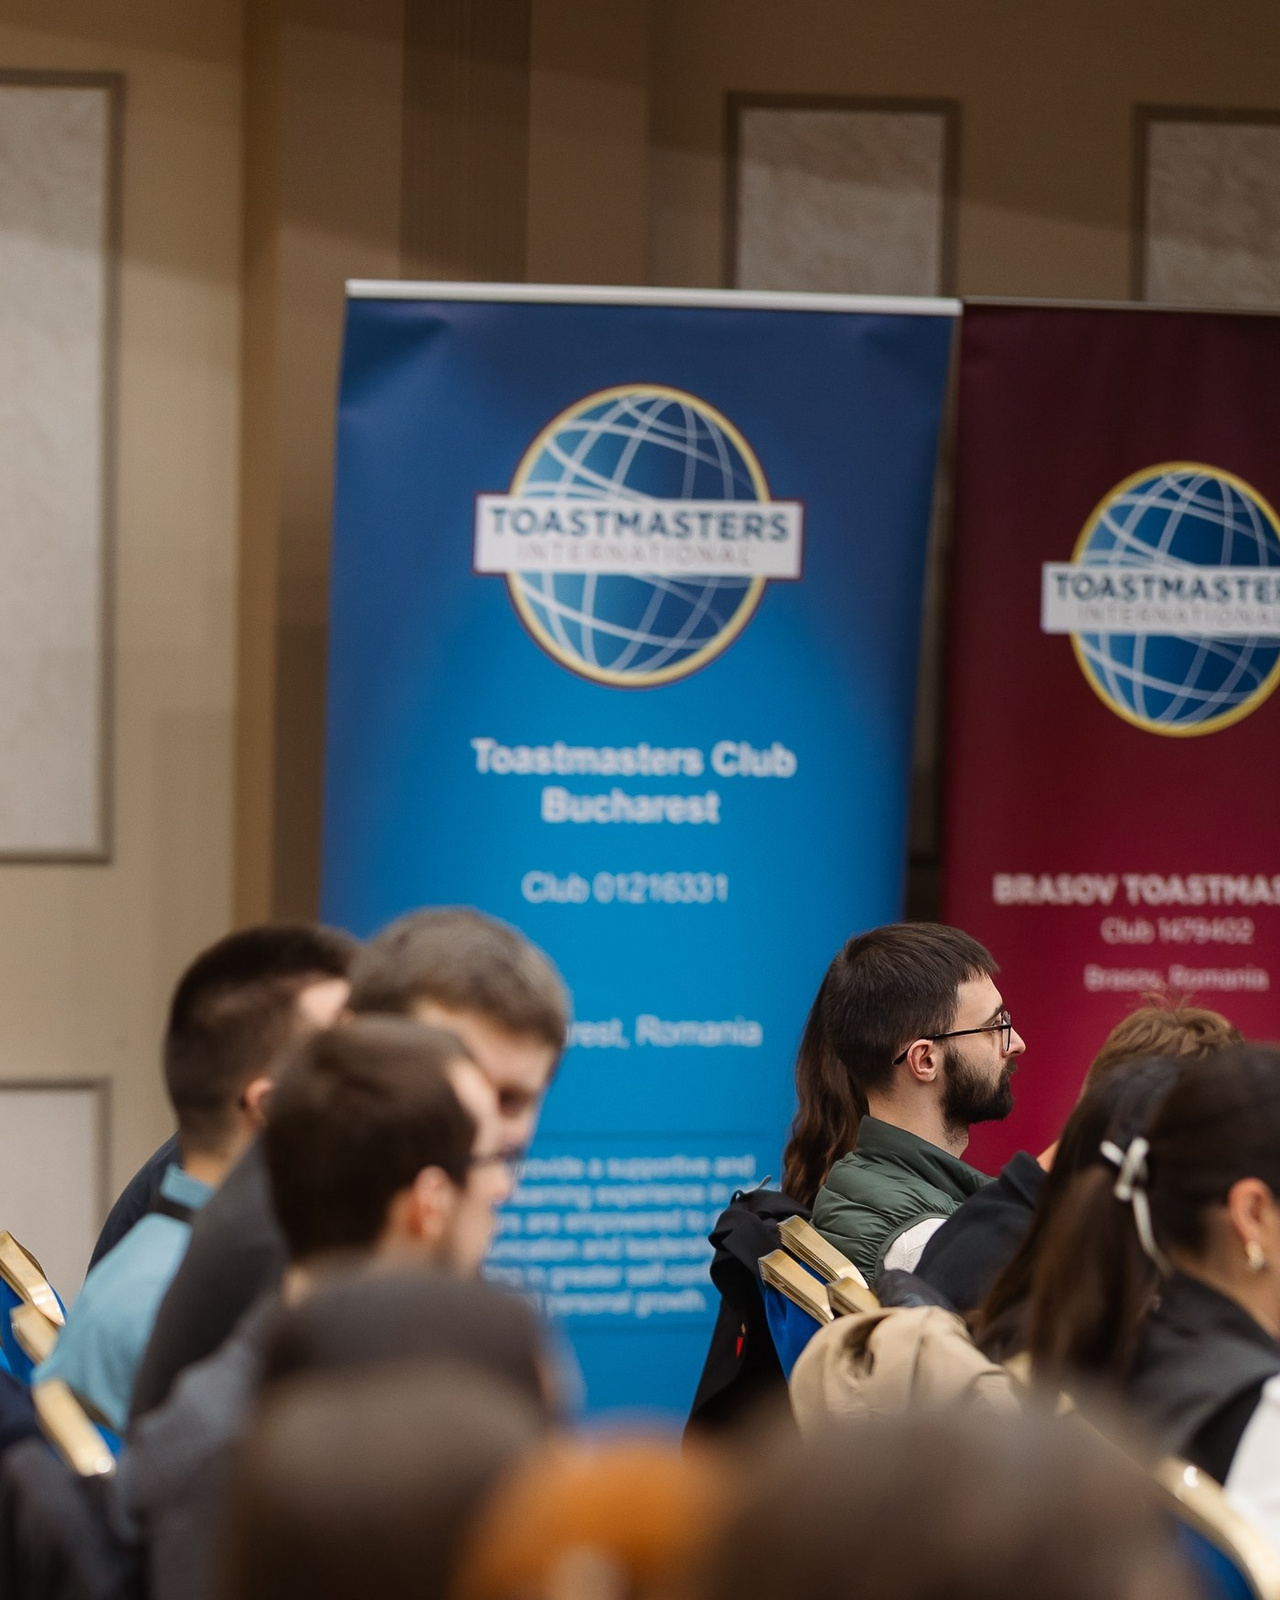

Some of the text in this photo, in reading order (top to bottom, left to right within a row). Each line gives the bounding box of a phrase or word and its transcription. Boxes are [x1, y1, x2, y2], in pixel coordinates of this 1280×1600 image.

[489, 507, 790, 541] TOASTMASTERS
[516, 541, 752, 567] INTERNATIONAL
[472, 738, 798, 778] Toastmasters Club
[542, 787, 720, 824] Bucharest
[522, 871, 590, 903] Club
[993, 873, 1118, 905] BRASOV
[1101, 917, 1155, 944] Club
[1170, 964, 1269, 992] Romania
[636, 1014, 763, 1047] Romania
